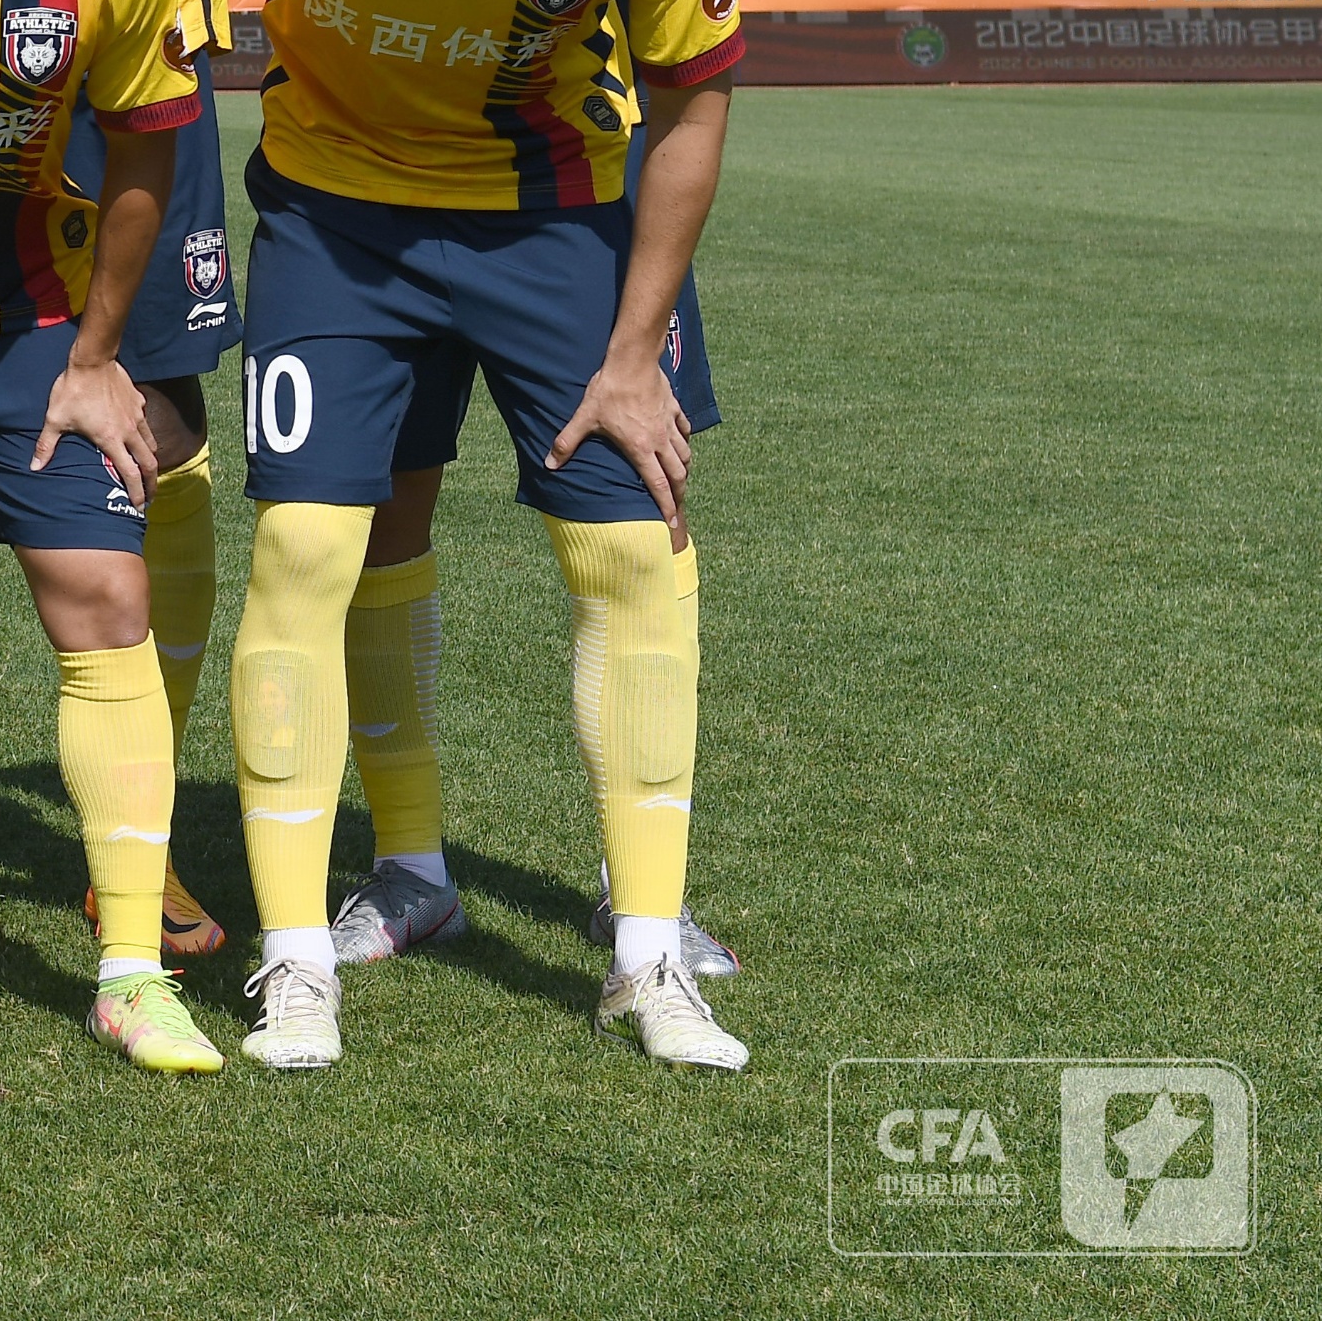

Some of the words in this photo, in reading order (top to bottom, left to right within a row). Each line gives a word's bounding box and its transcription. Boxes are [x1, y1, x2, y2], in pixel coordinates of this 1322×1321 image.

[9, 18, 71, 30] ATHLETIC
[975, 18, 1322, 48] 2022中国足球协会甲
[188, 315, 226, 331] LI-NIN
[245, 354, 313, 454] 10
